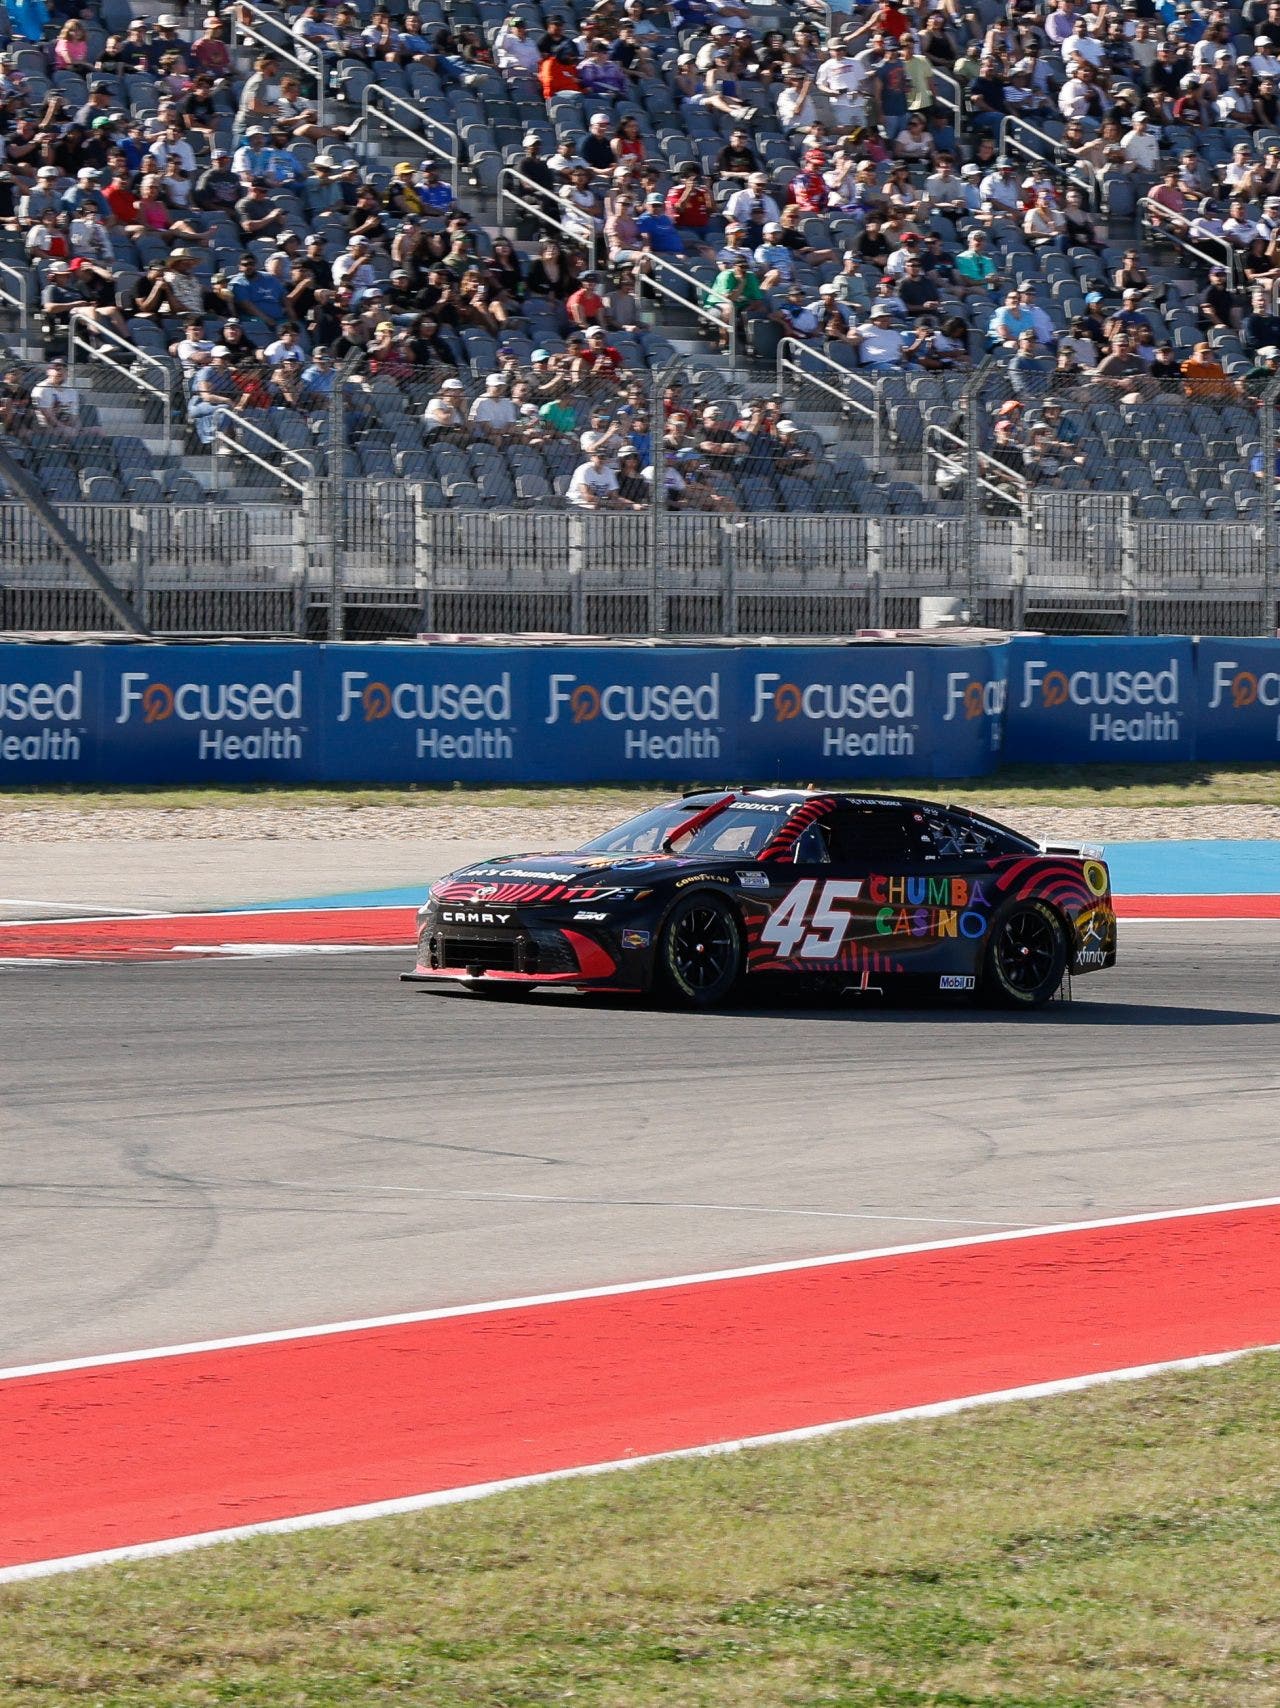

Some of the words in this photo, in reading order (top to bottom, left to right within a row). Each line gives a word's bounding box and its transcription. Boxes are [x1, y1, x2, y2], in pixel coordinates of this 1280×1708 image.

[116, 671, 301, 723] Focused
[338, 672, 510, 721] Focused
[546, 673, 719, 723] Focused
[751, 671, 914, 722] Focused
[1021, 659, 1178, 708] Focused
[823, 726, 914, 756] Health
[1090, 712, 1179, 742] Health
[0, 728, 80, 760] ealth
[199, 728, 301, 760] Health
[416, 728, 512, 759] Health
[625, 728, 720, 760] Health
[729, 802, 785, 812] EDDICK
[500, 869, 576, 882] Chumba!
[675, 873, 730, 888] GOODYEAR
[869, 874, 991, 907] CHUMBA
[443, 912, 511, 924] CAMRY
[761, 879, 863, 958] 45
[875, 907, 987, 939] CASINO
[1076, 946, 1107, 966] xfinity
[940, 976, 964, 989] Mobil
